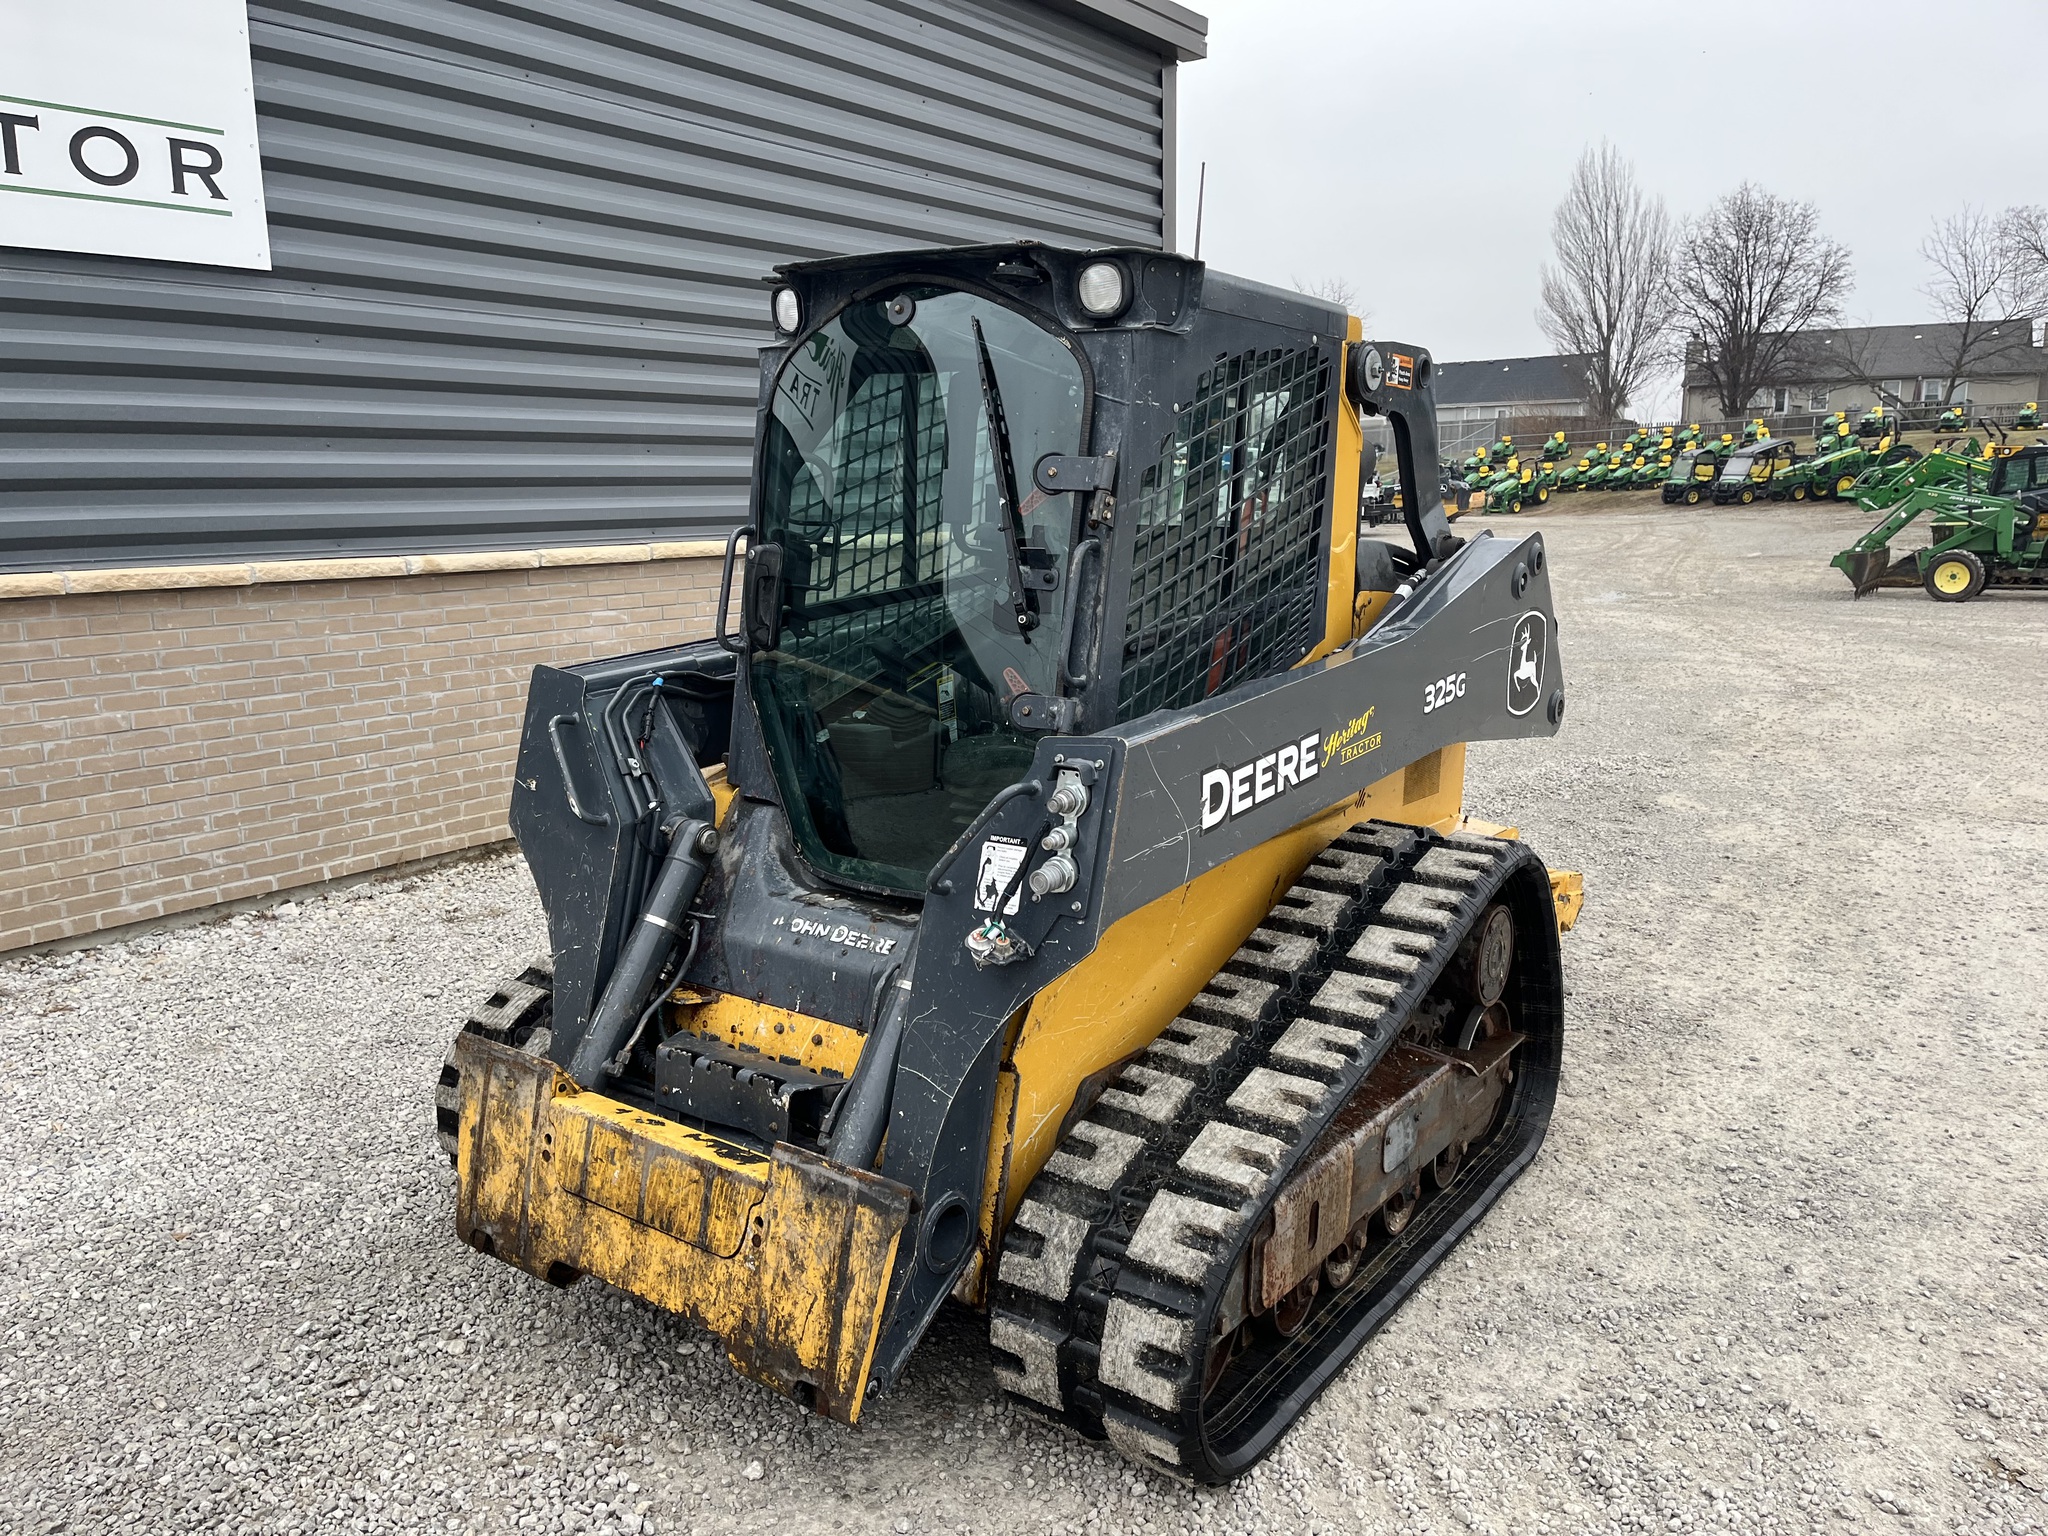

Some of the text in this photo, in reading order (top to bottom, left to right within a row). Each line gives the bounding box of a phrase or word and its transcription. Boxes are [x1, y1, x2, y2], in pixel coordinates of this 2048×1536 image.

[0, 112, 229, 200] TOR
[1424, 672, 1466, 714] 325G
[1341, 735, 1382, 761] TRACTOR
[1202, 733, 1320, 830] DEERE
[990, 835, 1021, 845] IMPORTANT
[788, 917, 832, 939] OHN
